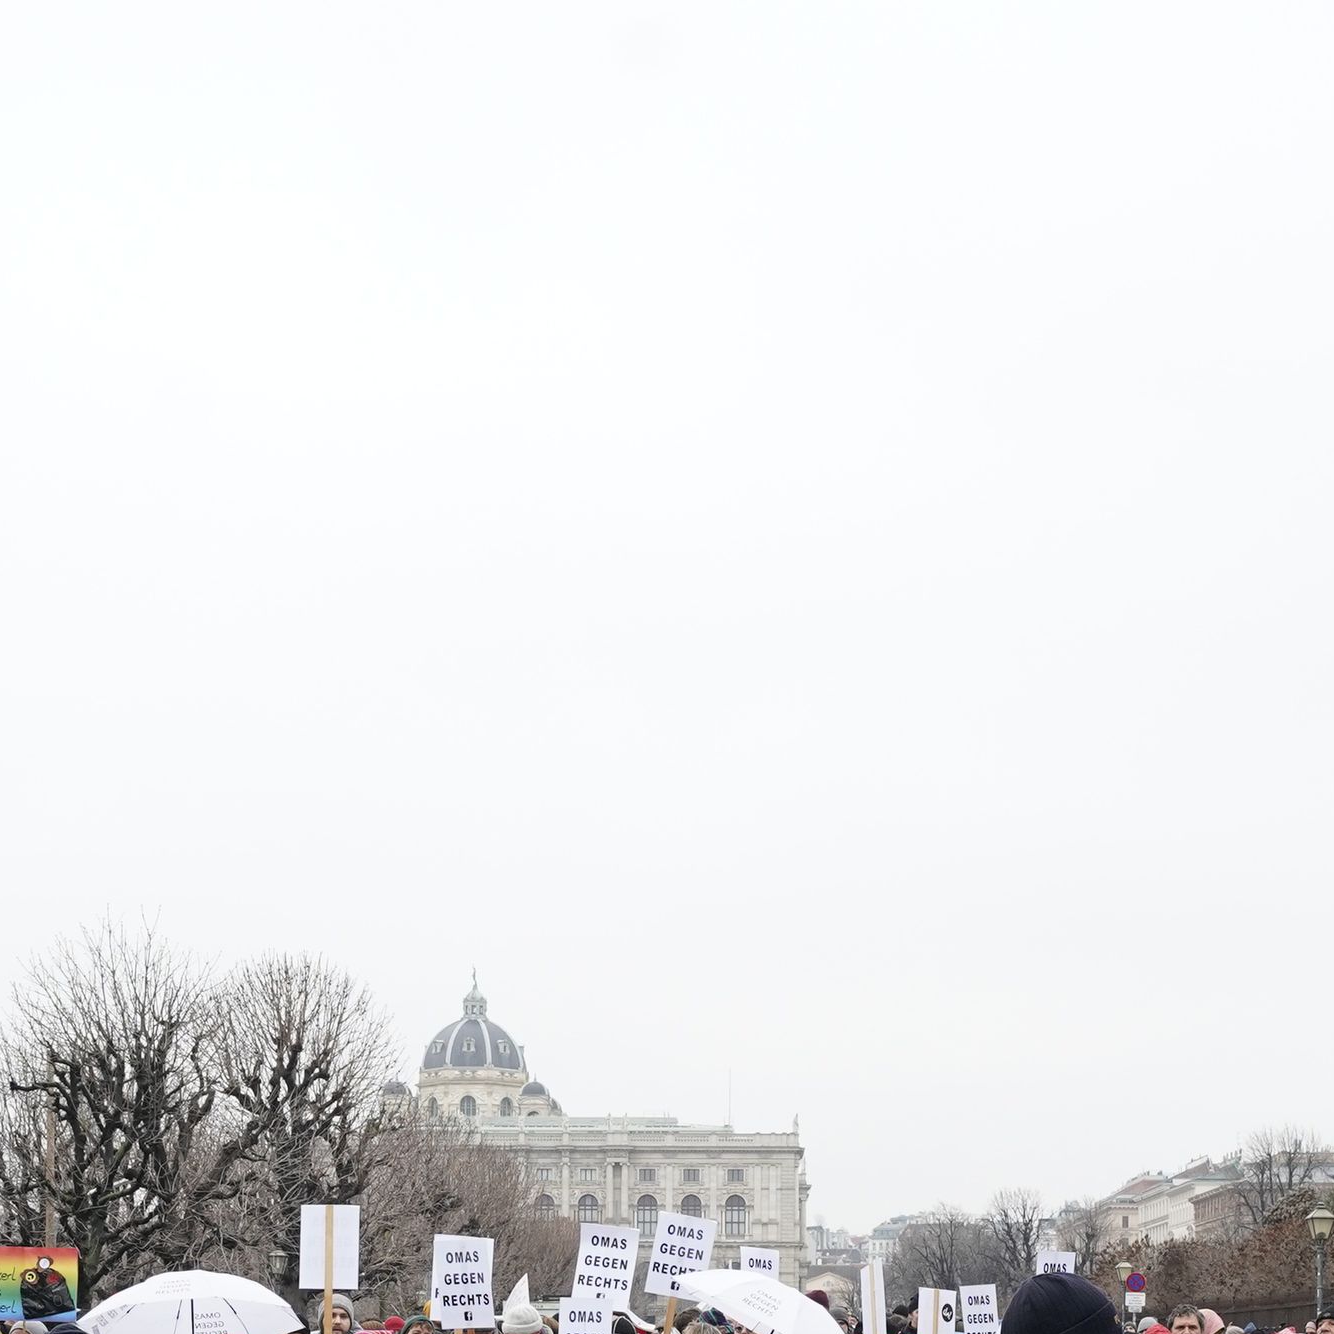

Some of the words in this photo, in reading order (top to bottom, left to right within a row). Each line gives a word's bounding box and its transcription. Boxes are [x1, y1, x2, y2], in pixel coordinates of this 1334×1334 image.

[667, 1224, 703, 1241] OMAS
[591, 1236, 627, 1250] OMAS
[445, 1250, 479, 1264] OMAS
[659, 1242, 704, 1261] GEGEN
[585, 1255, 629, 1270] GEGEN
[652, 1261, 702, 1276] RECH
[748, 1258, 773, 1270] OMAS
[1043, 1262, 1067, 1274] OMAS
[444, 1272, 485, 1286] GEGEN
[577, 1274, 629, 1291] RECHTS
[443, 1293, 490, 1307] RECHTS
[967, 1294, 991, 1306] OMAS
[569, 1310, 603, 1323] OMAS
[967, 1314, 995, 1324] GEGEN
